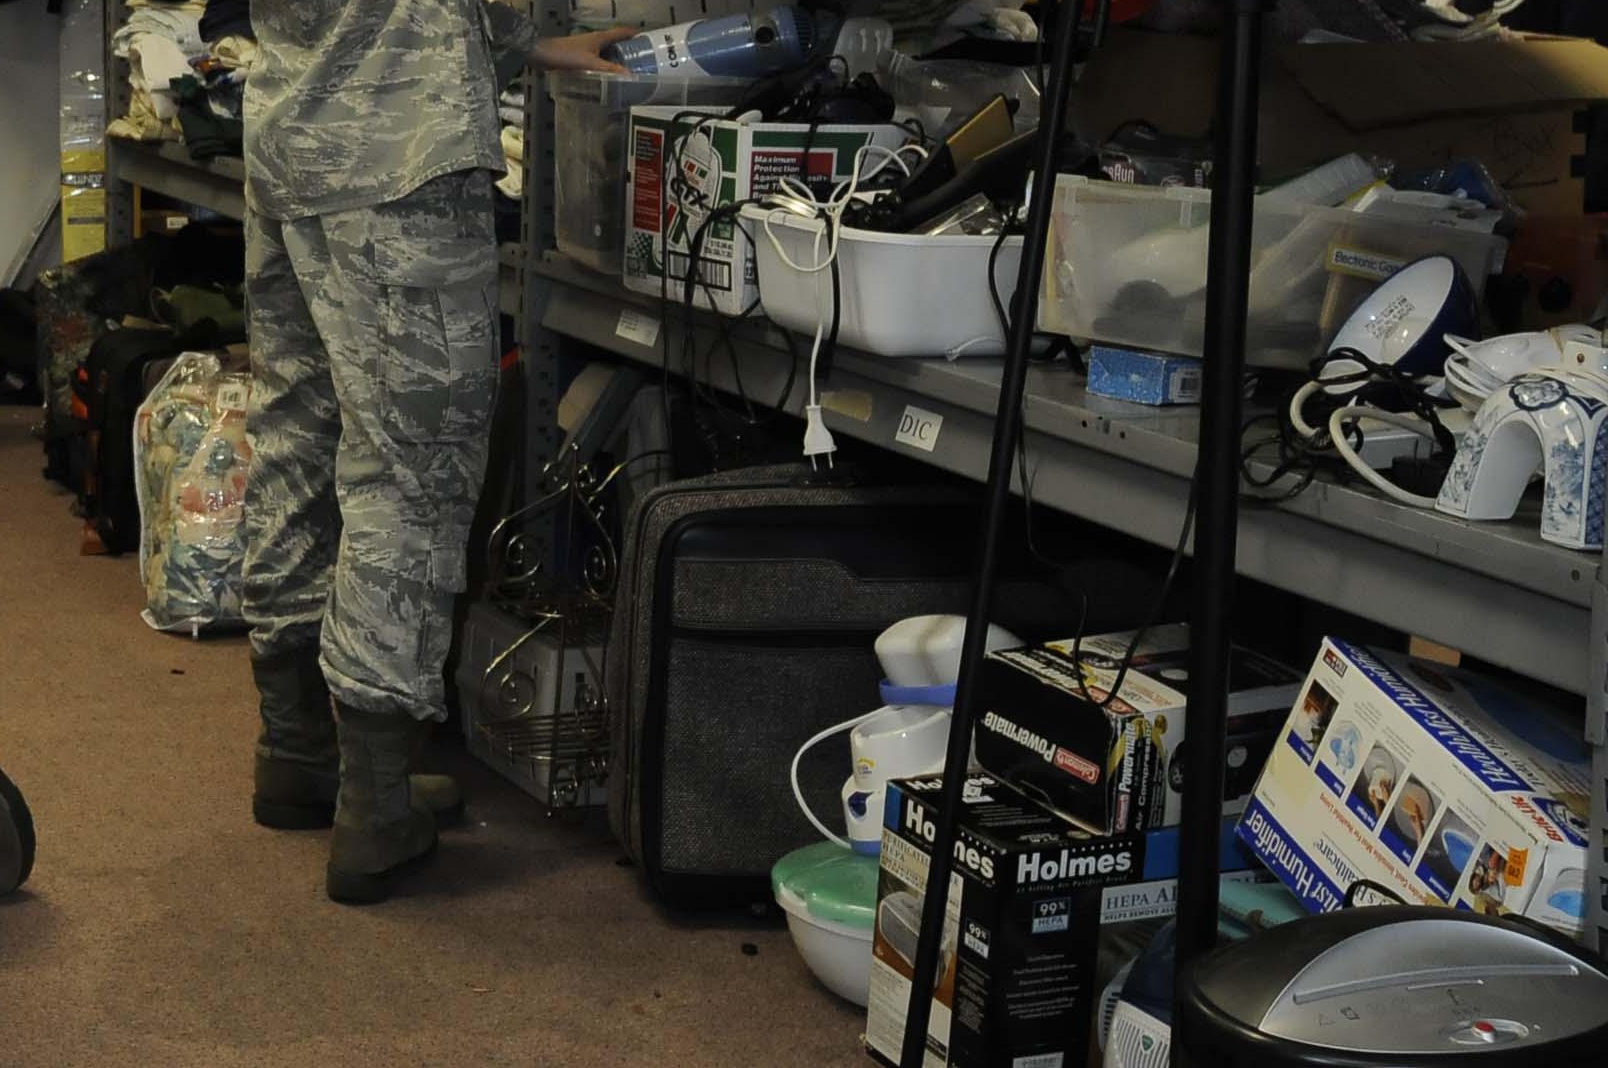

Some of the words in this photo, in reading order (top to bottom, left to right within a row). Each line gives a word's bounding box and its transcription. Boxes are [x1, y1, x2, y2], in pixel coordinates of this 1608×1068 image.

[754, 164, 800, 172] Protection
[984, 711, 1057, 763] Powermate
[1118, 721, 1136, 793] Powermate
[1056, 750, 1099, 782] Coleman
[1138, 723, 1152, 806] Compressor
[906, 798, 995, 881] Homes
[1245, 810, 1318, 898] Humidifier
[1017, 849, 1131, 883] Holmes
[1037, 915, 1064, 928] HEPA
[1106, 892, 1149, 911] HEPA
